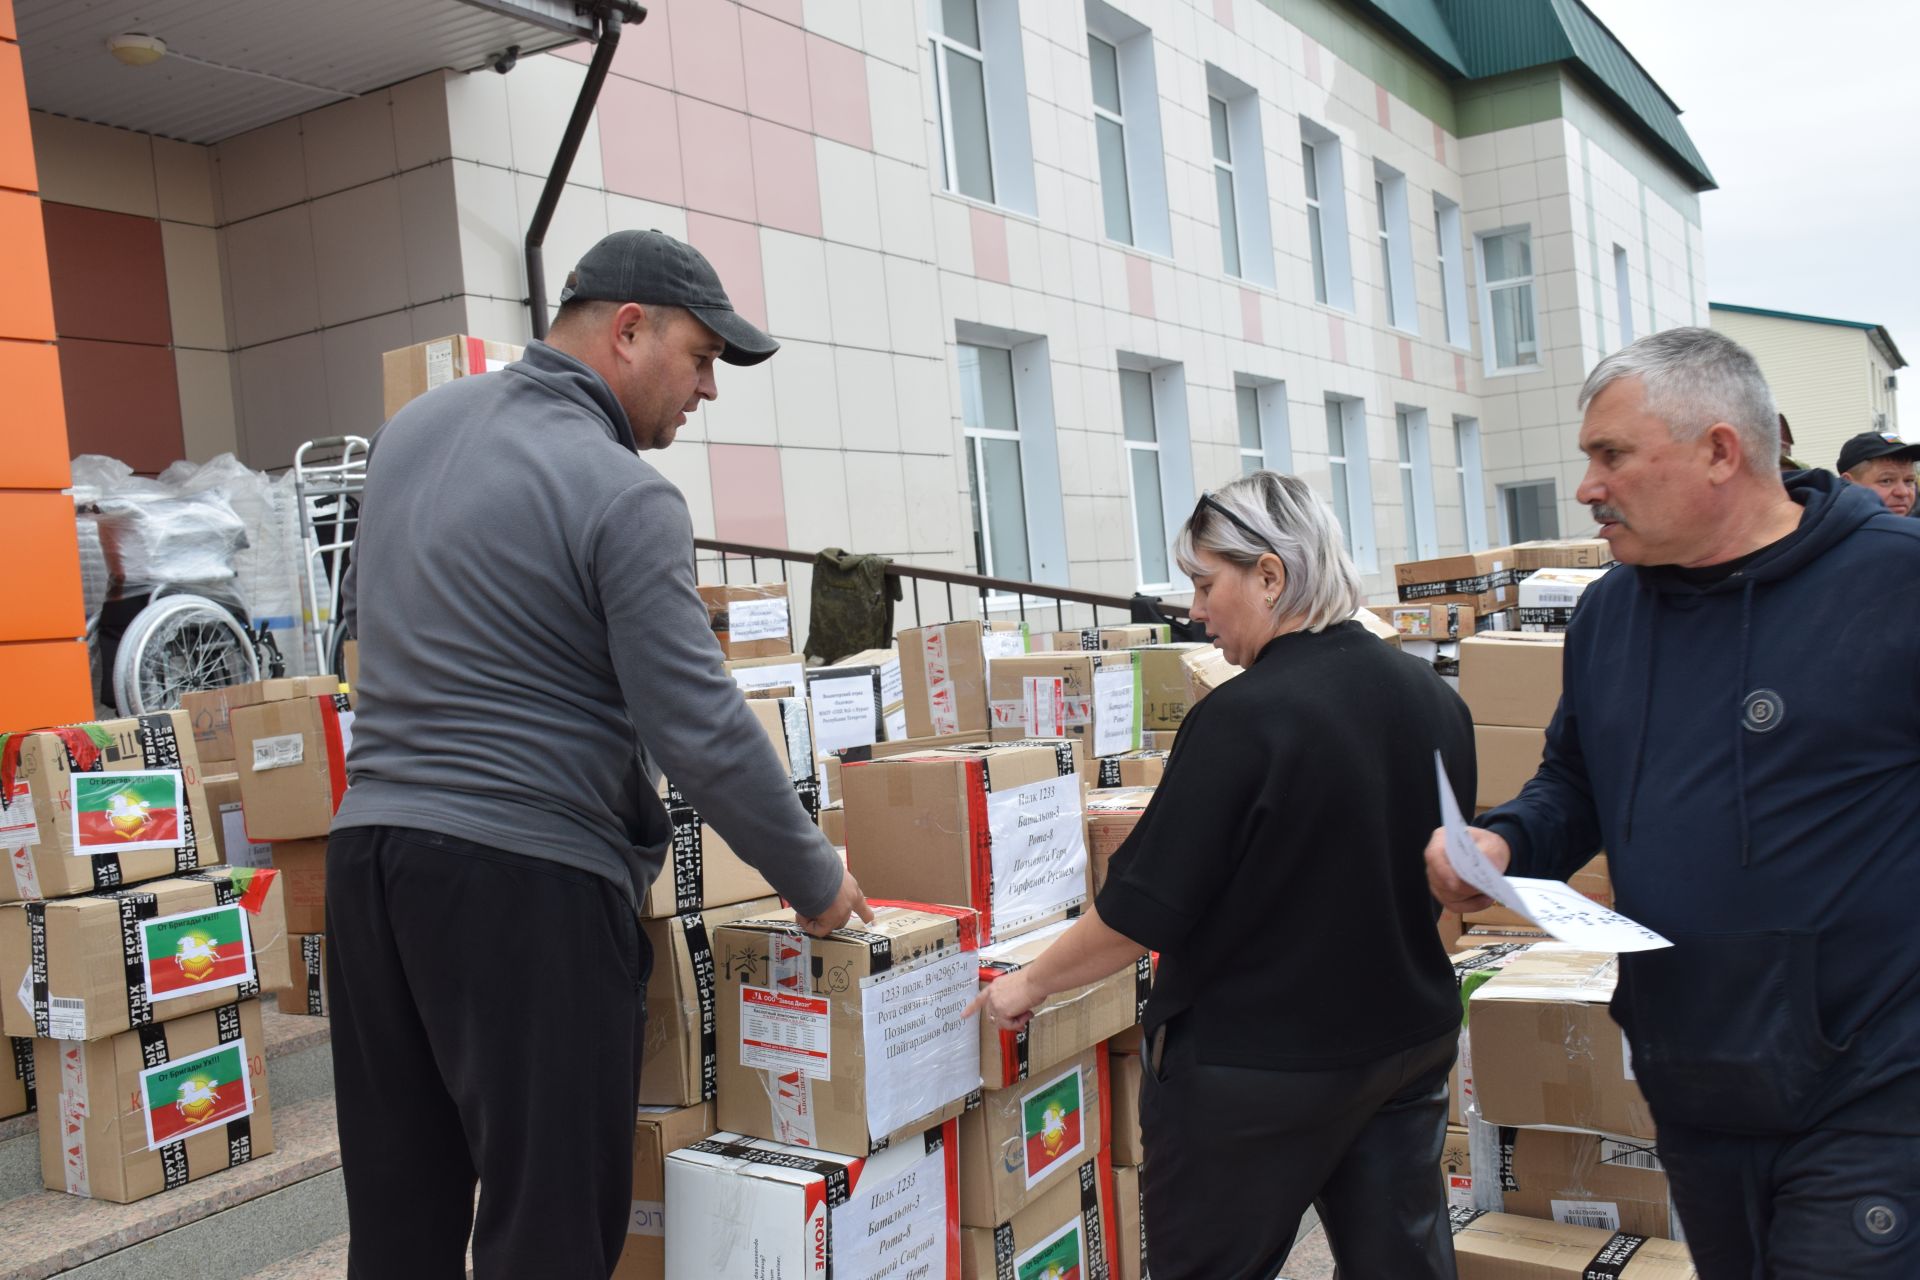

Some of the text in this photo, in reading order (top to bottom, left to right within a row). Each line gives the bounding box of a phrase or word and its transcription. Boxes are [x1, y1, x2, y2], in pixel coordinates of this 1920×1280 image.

[1018, 785, 1056, 807] Полк 1233
[1027, 828, 1054, 847] Рота-8
[674, 824, 686, 897] КРУТЫХ
[169, 917, 201, 930] Бригады
[872, 940, 889, 954] ДЛЯ
[881, 985, 900, 1005] 1233
[878, 1009, 897, 1025] Рота
[898, 1000, 921, 1016] связи
[884, 1014, 926, 1041] Позывной
[934, 998, 967, 1023] Француз
[886, 1027, 941, 1060] Шайгарданов
[158, 1055, 220, 1082] От Бригады Ух!!!
[827, 1170, 846, 1187] ДЛЯ
[871, 1172, 916, 1210] Полк 1233
[867, 1194, 920, 1237] Батальон-3
[814, 1216, 825, 1271] ROWE
[878, 1223, 911, 1255] Рота-8
[900, 1233, 935, 1265] Сварной
